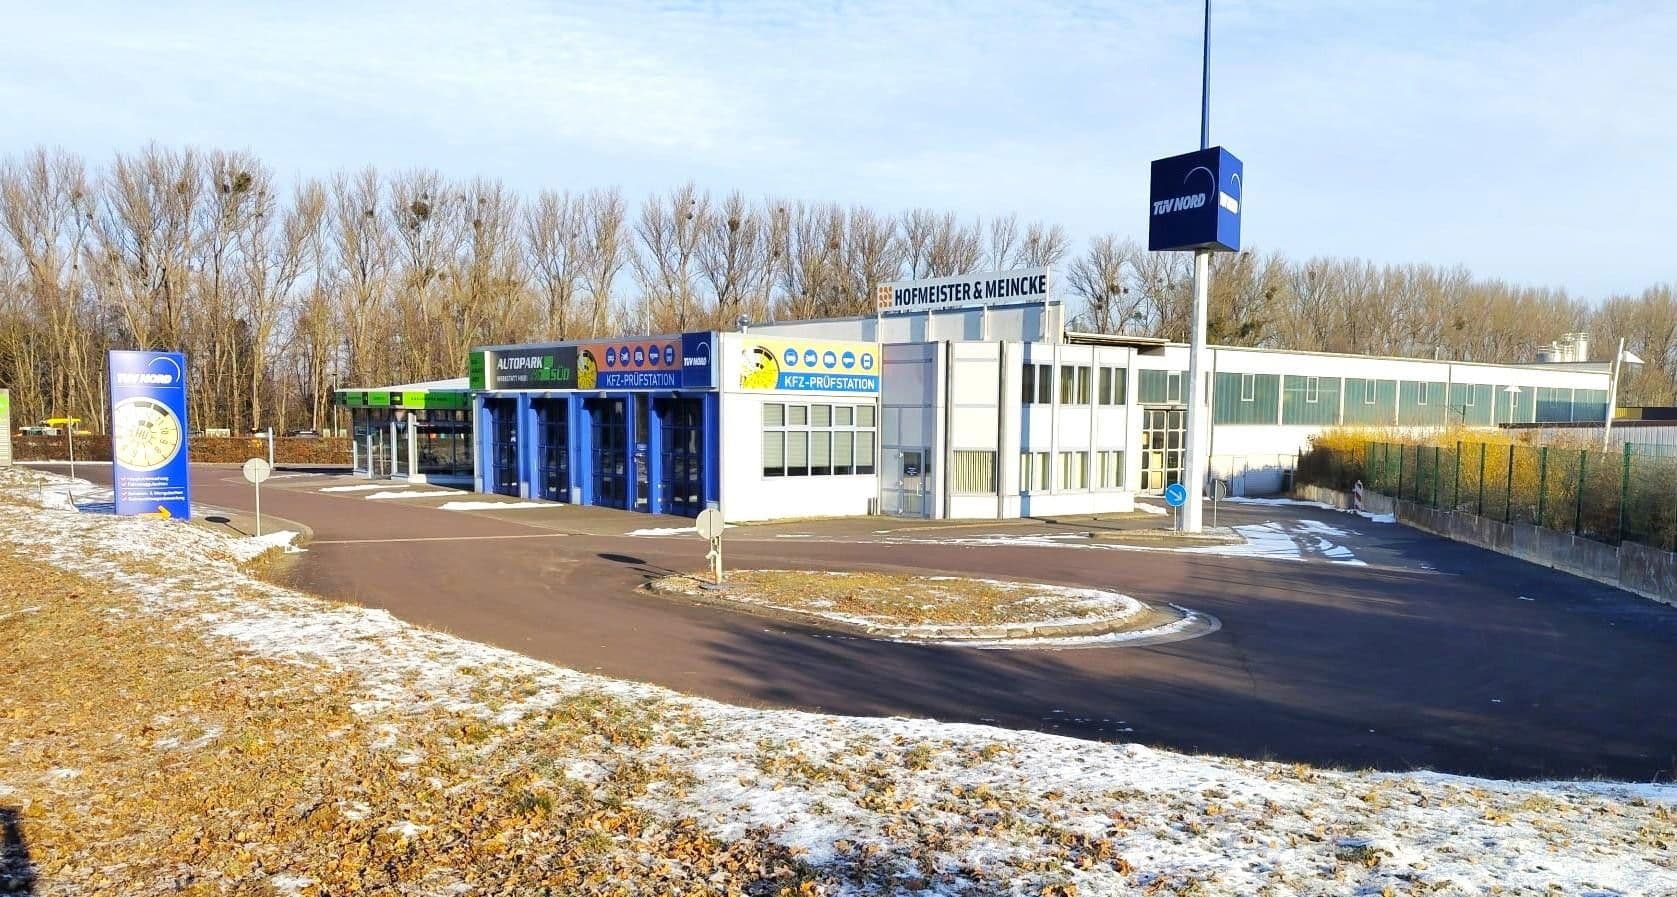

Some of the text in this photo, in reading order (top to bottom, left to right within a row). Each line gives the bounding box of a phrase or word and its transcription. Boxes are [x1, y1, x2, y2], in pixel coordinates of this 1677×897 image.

[1153, 199, 1174, 215] TÜV
[1173, 193, 1206, 211] NORD
[895, 275, 1047, 307] HOFMEISTER & MEINCKE
[496, 356, 543, 370] AUTOPARK
[693, 357, 706, 366] NORD
[550, 365, 570, 380] SÜD
[606, 372, 675, 386] KFZ-PRÜFSTATION
[784, 375, 875, 390] KFZ-PRÜFSTATION
